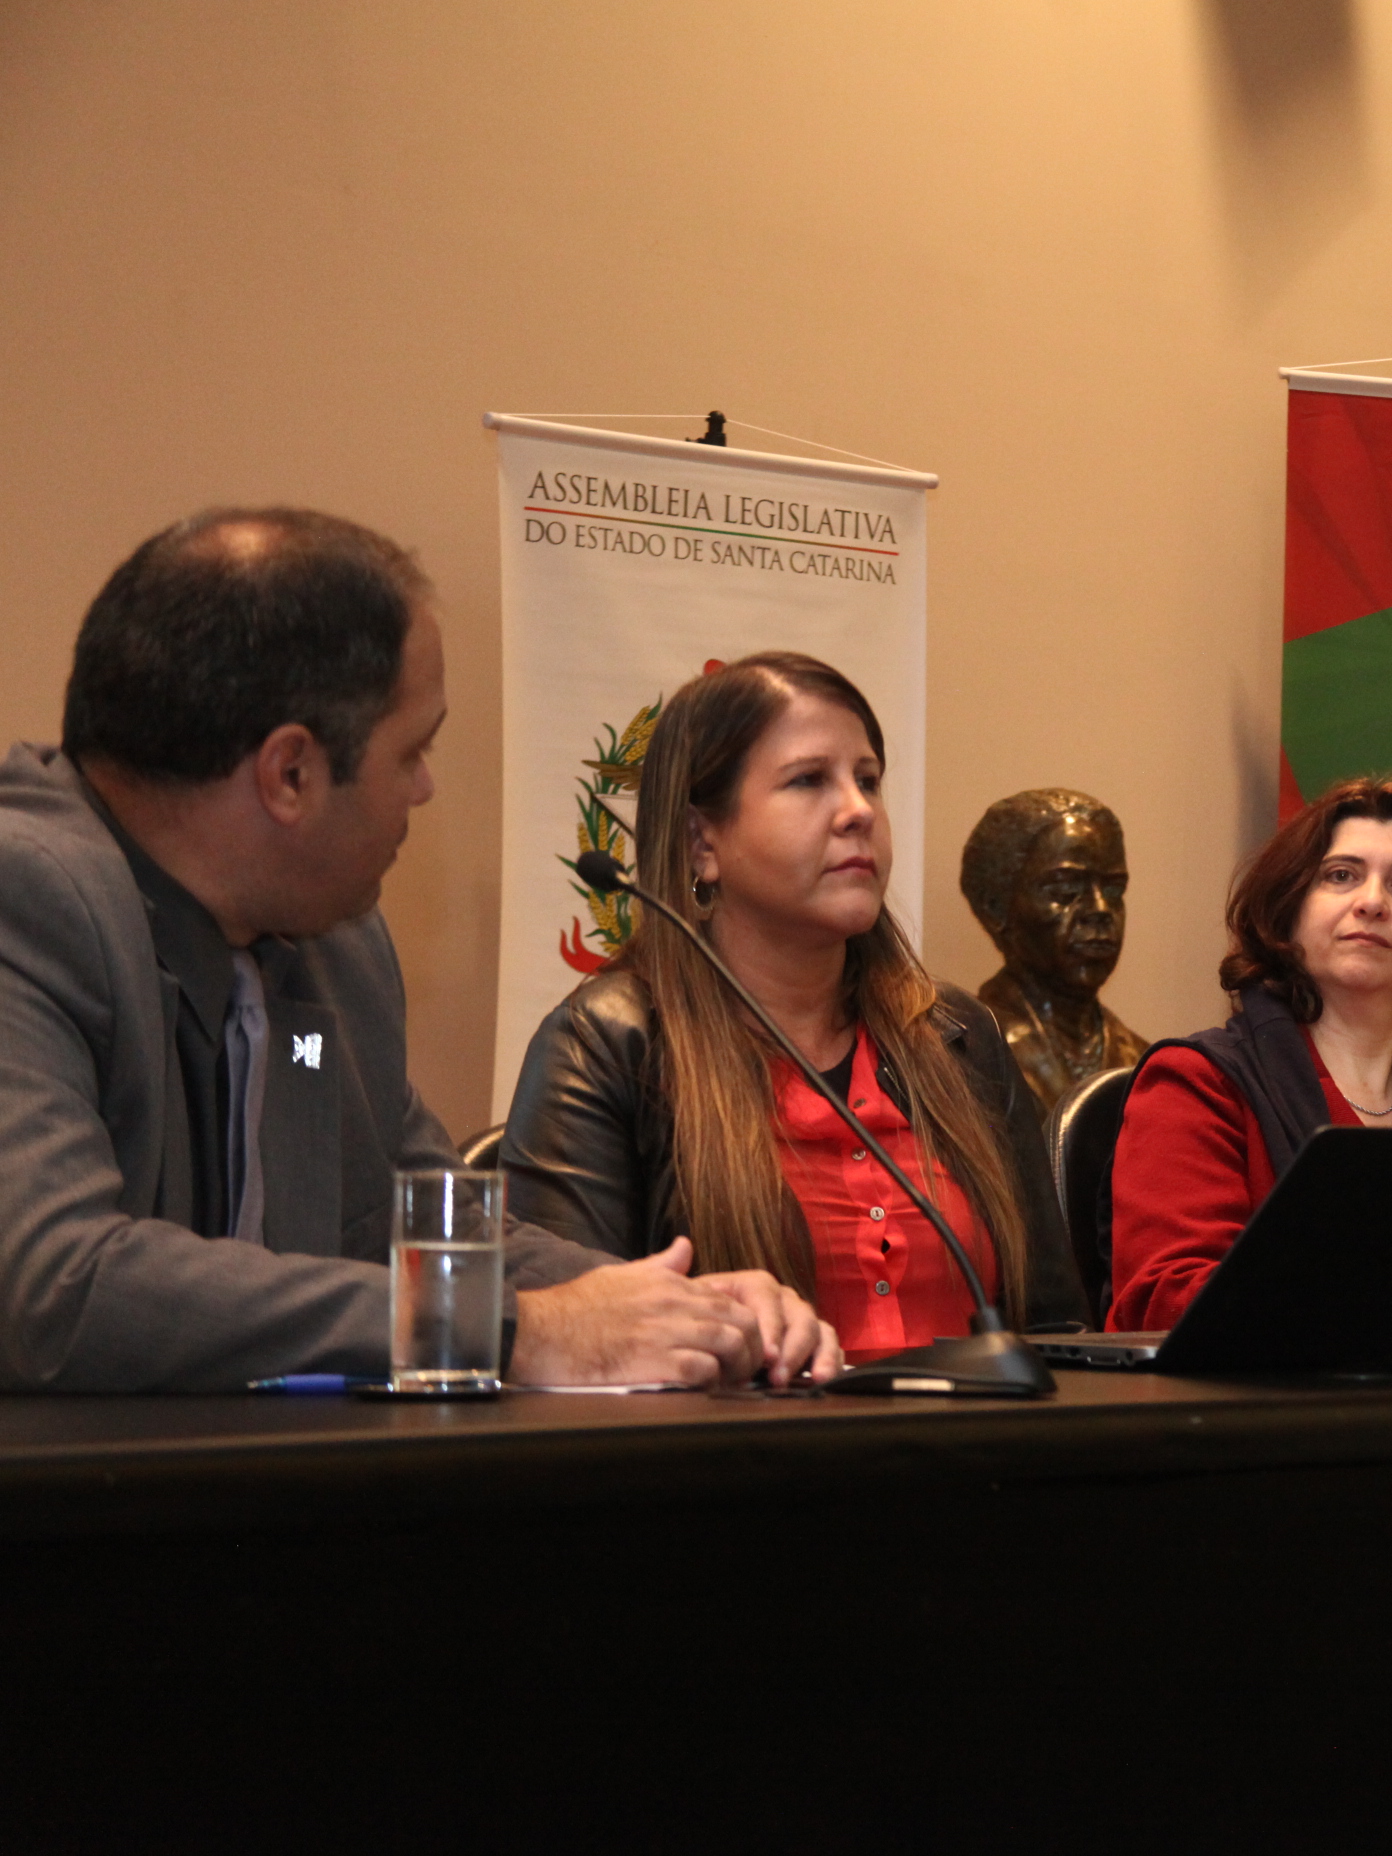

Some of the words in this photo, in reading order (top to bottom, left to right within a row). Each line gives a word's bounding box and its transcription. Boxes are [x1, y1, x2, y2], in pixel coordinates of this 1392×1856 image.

[527, 470, 713, 521] ASSEMBLEIA
[723, 494, 898, 545] LEGISLATIVA
[525, 518, 567, 545] DO
[575, 523, 666, 557] ESTADO
[674, 536, 703, 563] DE
[711, 540, 784, 572] SANTA
[789, 550, 897, 585] CATARINA
